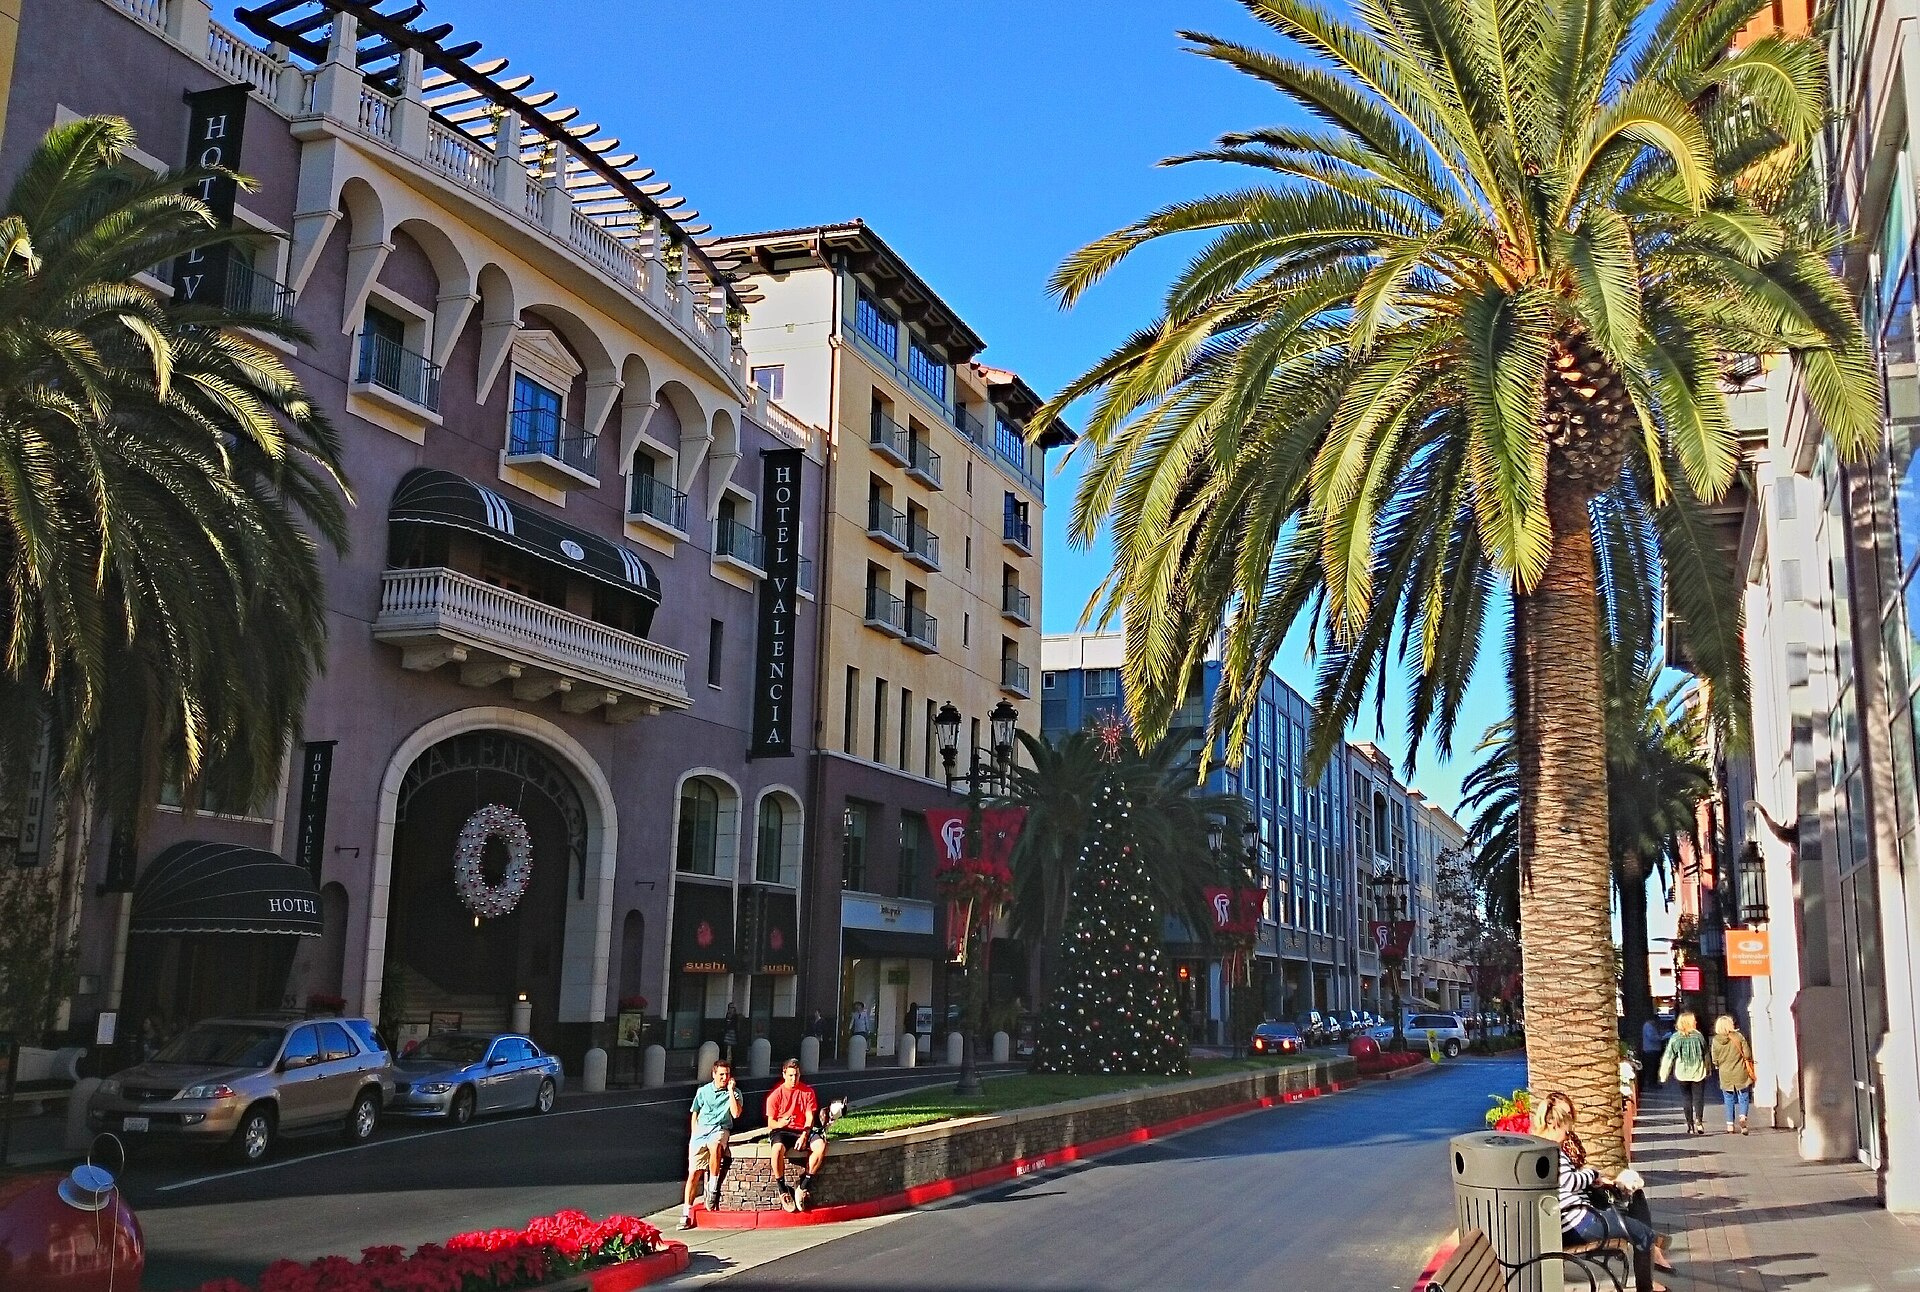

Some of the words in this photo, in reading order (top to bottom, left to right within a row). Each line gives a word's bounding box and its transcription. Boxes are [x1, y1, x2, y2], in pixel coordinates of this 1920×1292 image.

[187, 114, 227, 264] HOTL
[774, 466, 792, 564] HOTEL
[766, 577, 788, 744] VALENCIA
[310, 752, 322, 802] HOTEL
[303, 813, 315, 865] VALEN
[268, 897, 317, 914] HOTEL
[685, 961, 727, 970] sushi
[762, 964, 795, 972] sushi
